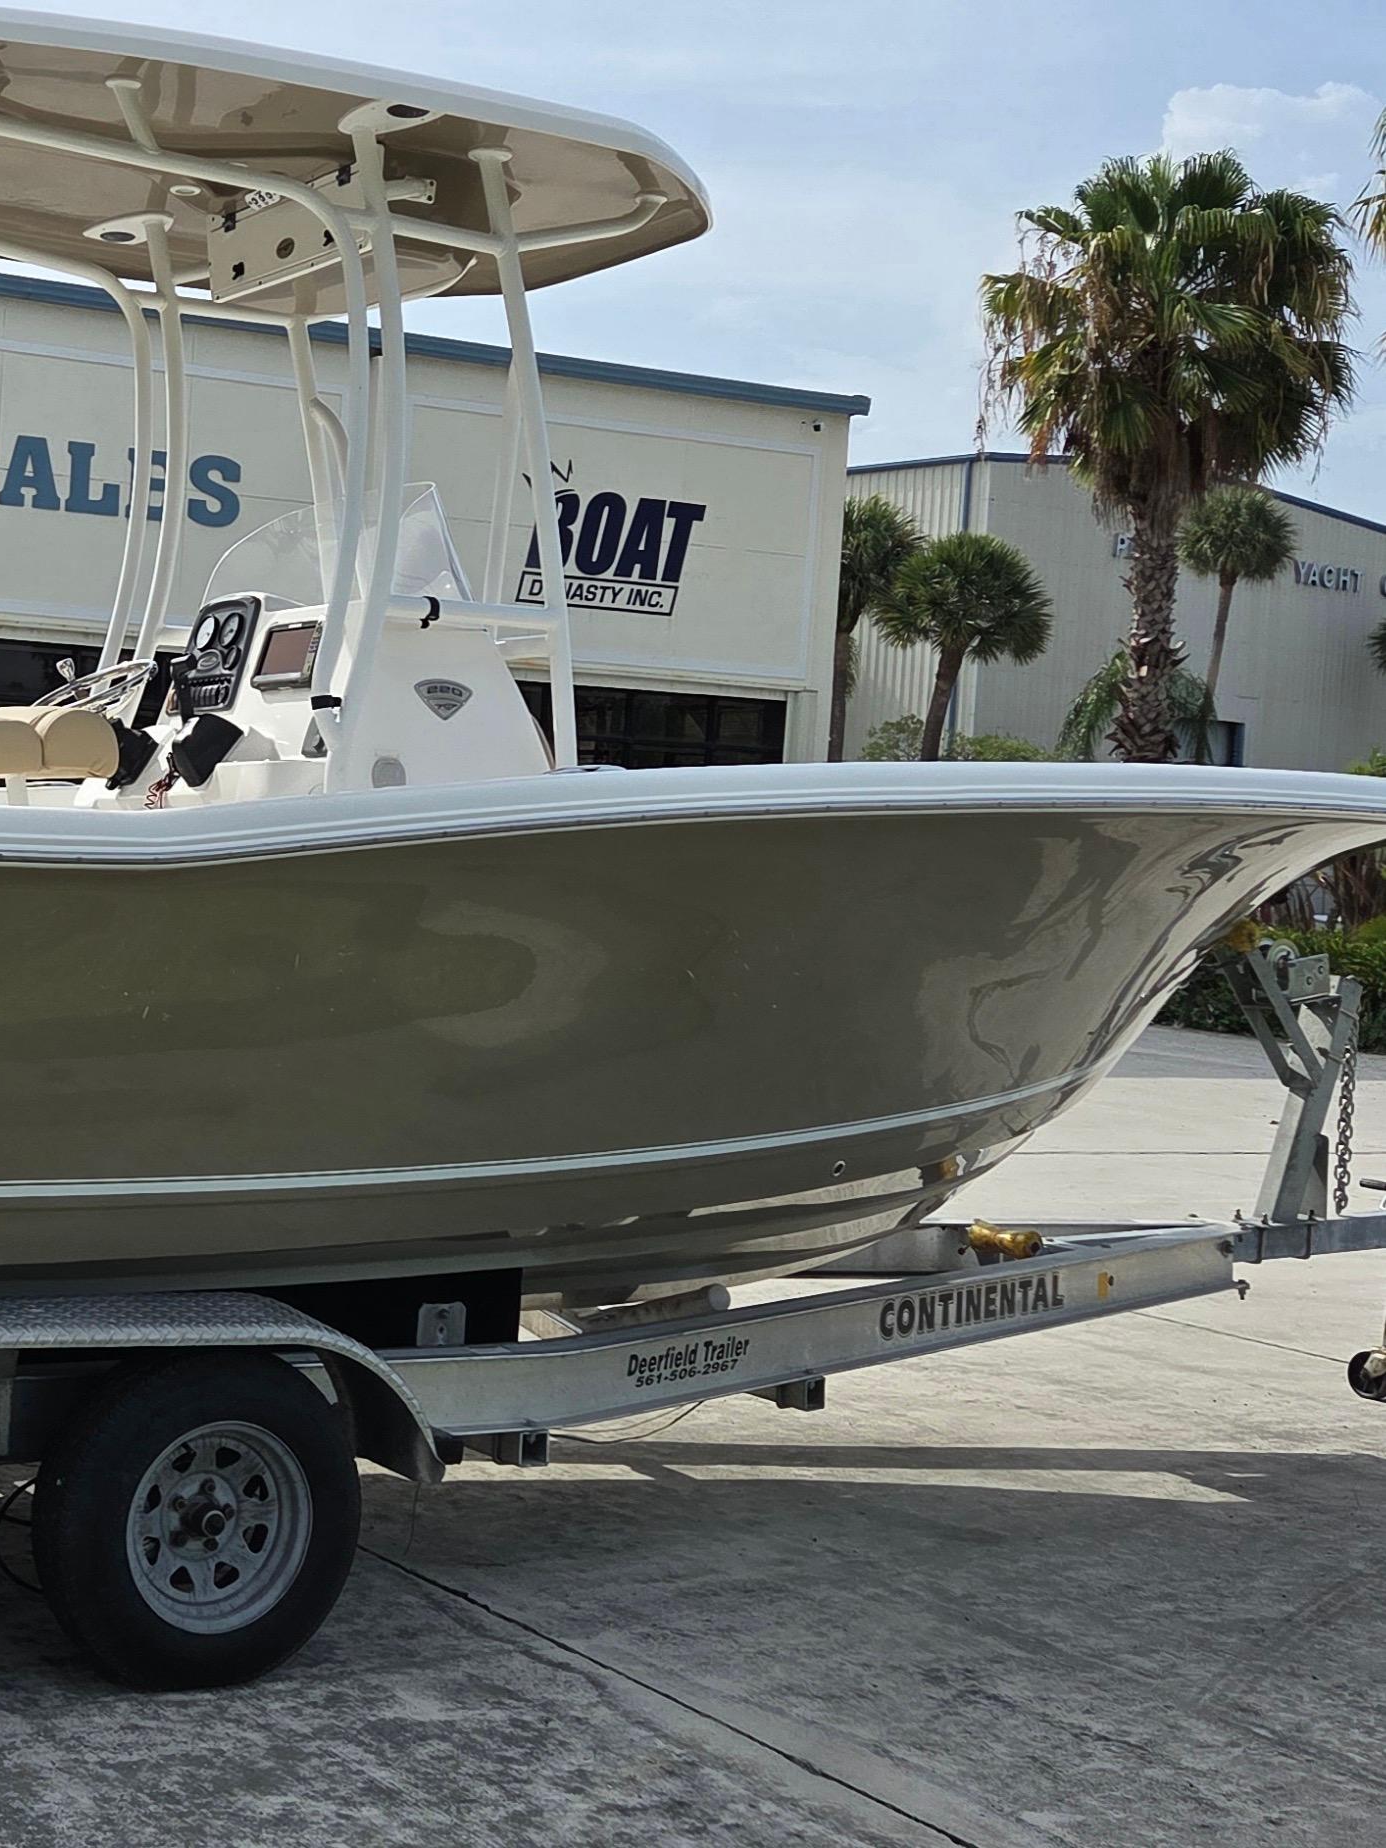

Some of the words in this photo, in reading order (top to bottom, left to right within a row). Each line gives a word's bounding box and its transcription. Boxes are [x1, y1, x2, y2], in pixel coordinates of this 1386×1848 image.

[525, 491, 707, 583] BOAT
[528, 579, 624, 604] DASTY
[626, 588, 665, 609] INC.
[1294, 559, 1365, 594] YACHT
[879, 1271, 1065, 1341] CONTINENTAL
[626, 1341, 699, 1377] Deerfield
[703, 1336, 750, 1363] Trailer
[634, 1358, 739, 1388] 561-506-2967
